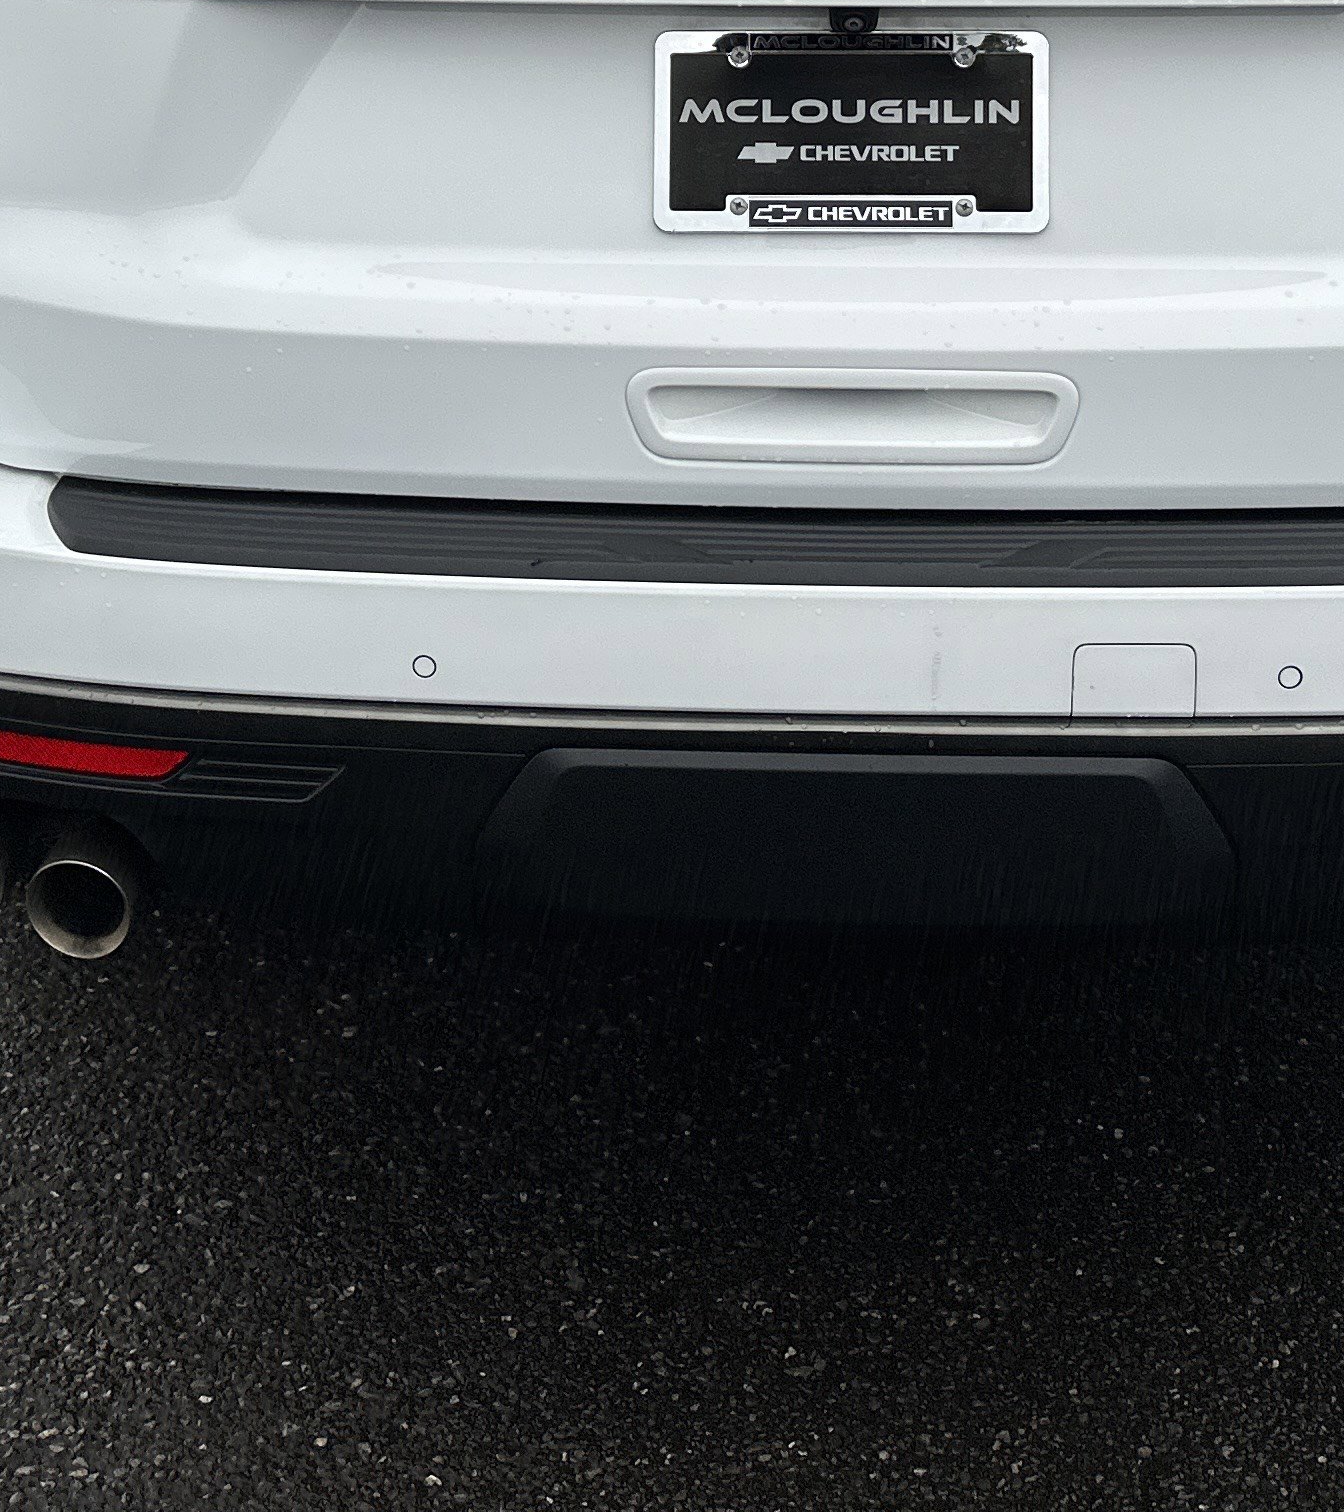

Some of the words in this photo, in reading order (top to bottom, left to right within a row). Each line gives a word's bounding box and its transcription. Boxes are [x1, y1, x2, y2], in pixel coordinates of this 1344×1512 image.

[753, 33, 951, 50] MCLOUGHLIN
[678, 98, 1021, 125] MCLOUGHLIN
[799, 144, 960, 162] CHEVROLET
[807, 205, 950, 222] CHEVROLET
